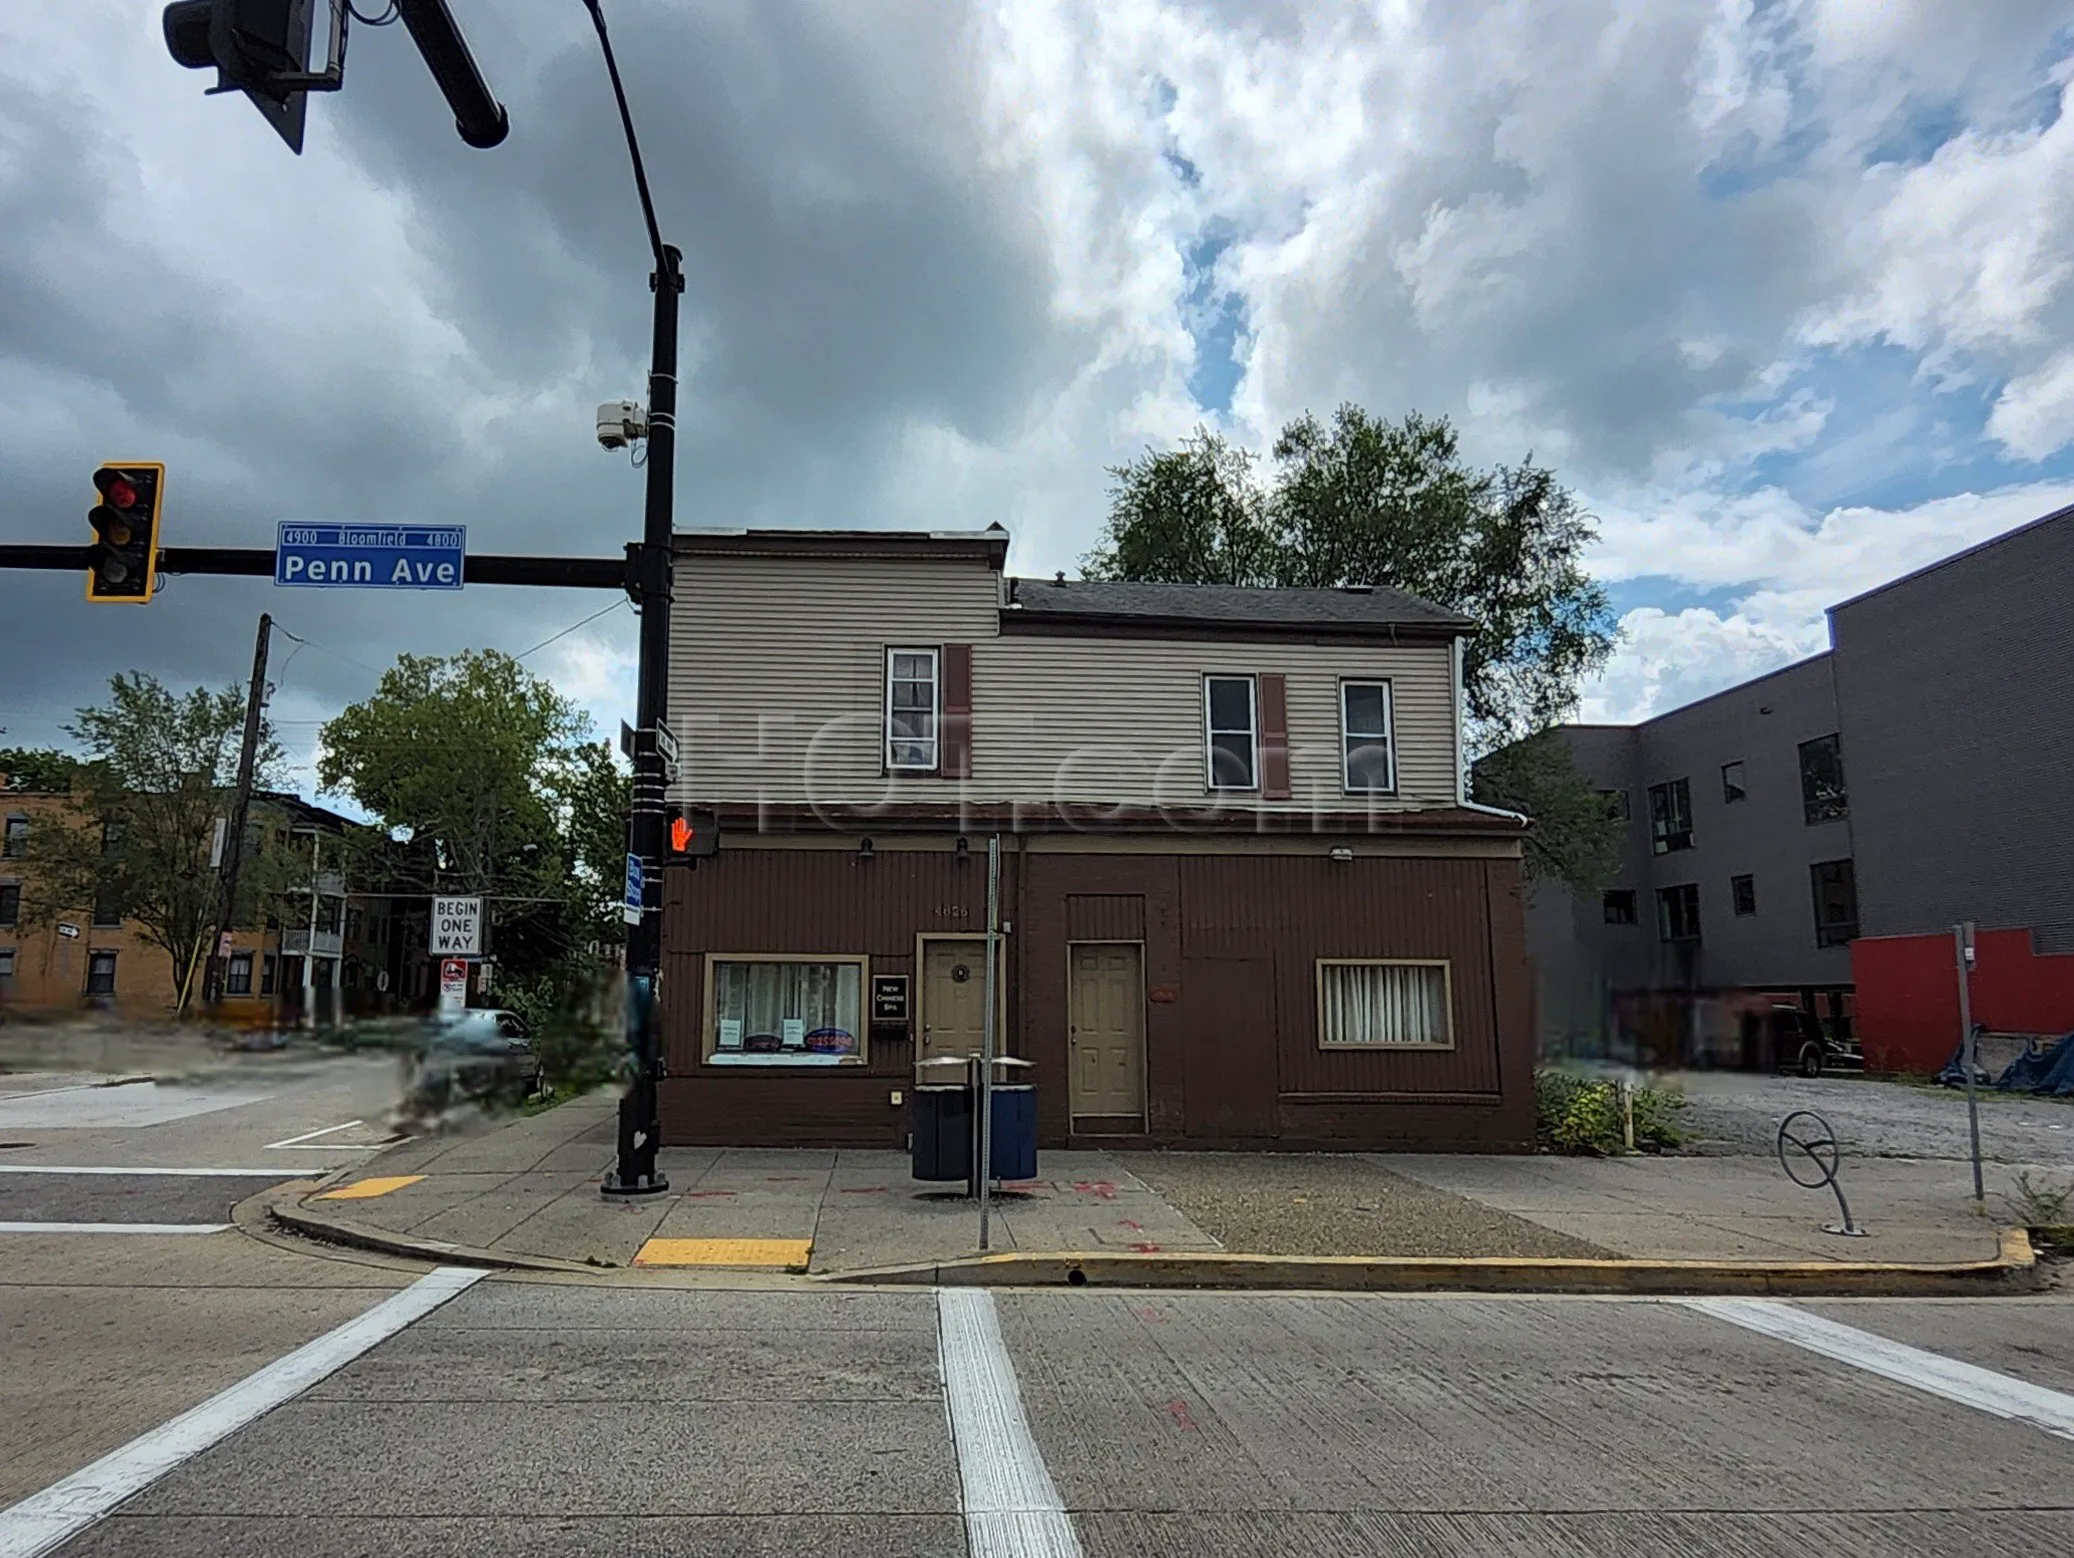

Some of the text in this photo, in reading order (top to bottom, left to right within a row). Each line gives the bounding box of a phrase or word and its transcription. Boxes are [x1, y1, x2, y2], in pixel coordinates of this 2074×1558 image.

[286, 531, 458, 547] 4900 Bloomfield 4800
[285, 555, 455, 583] Penn Ave
[437, 901, 478, 916] BEGIN
[441, 919, 472, 933] ONE
[438, 936, 473, 950] WAY
